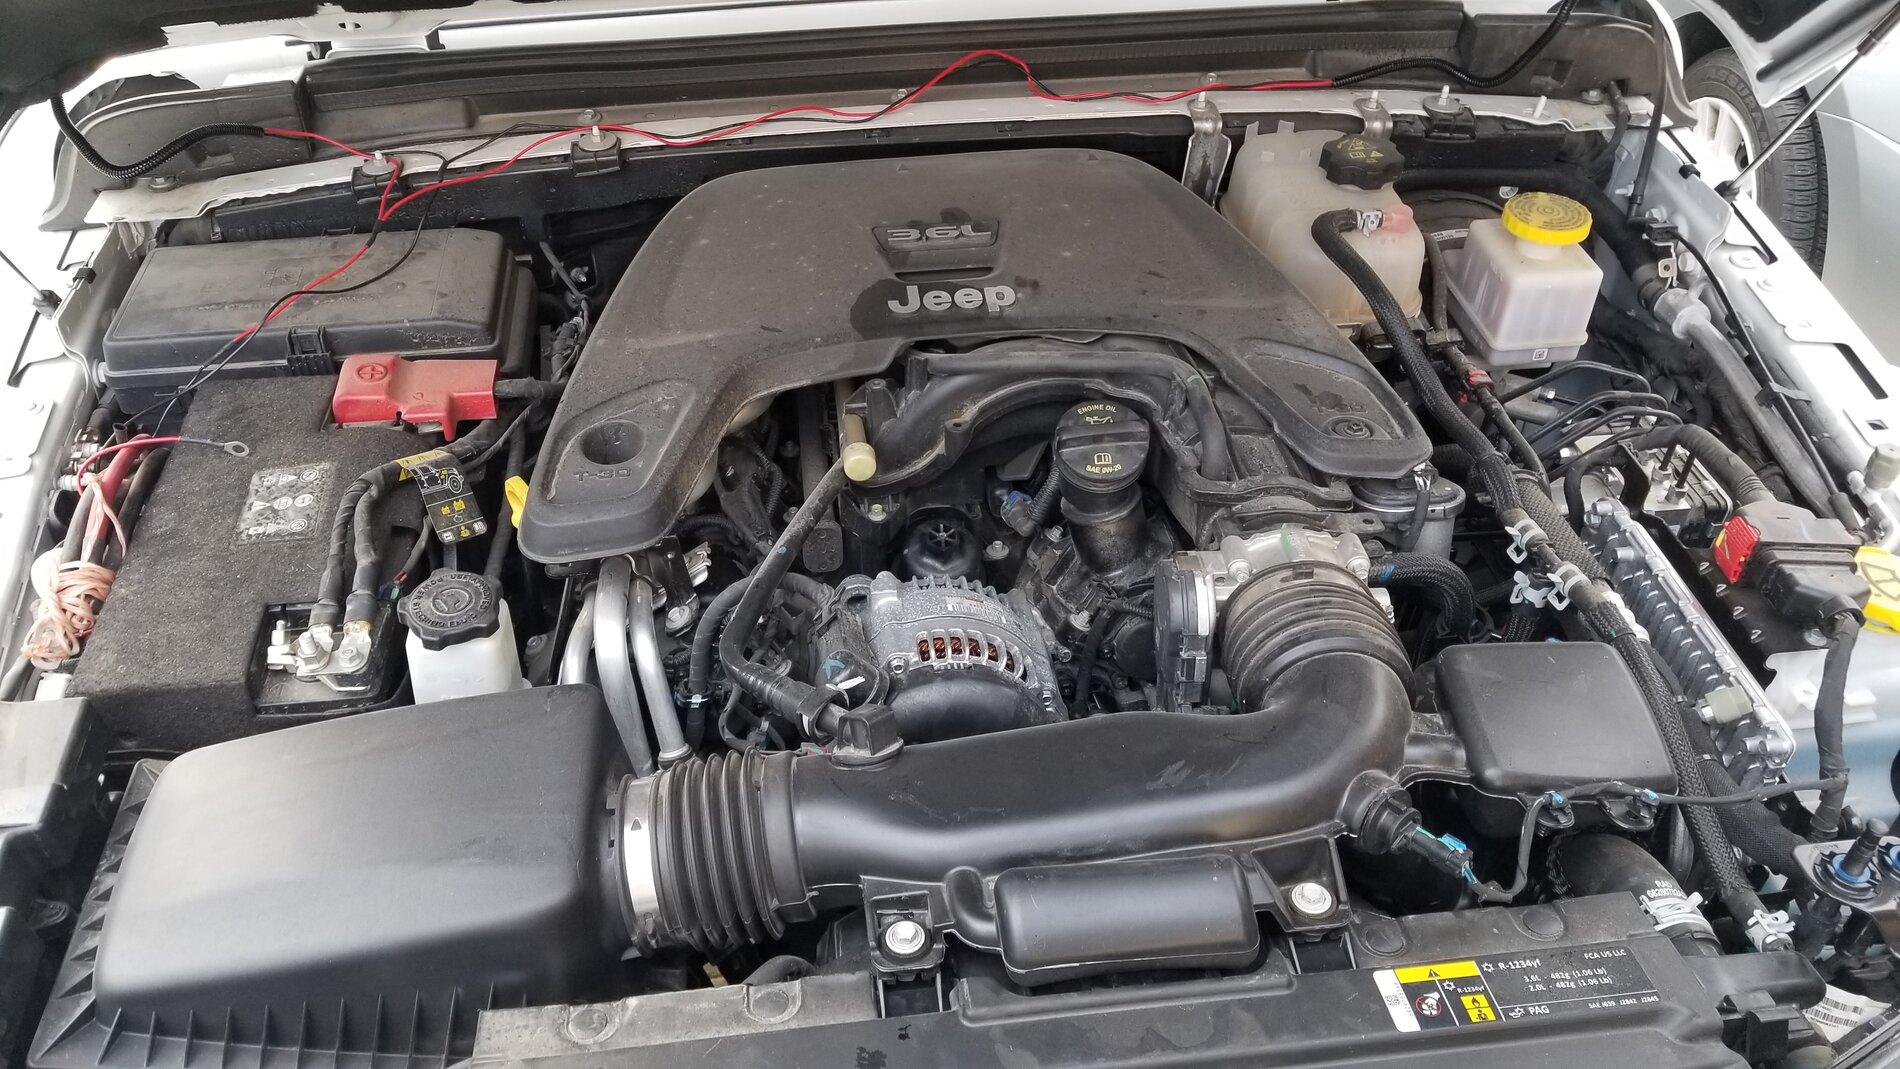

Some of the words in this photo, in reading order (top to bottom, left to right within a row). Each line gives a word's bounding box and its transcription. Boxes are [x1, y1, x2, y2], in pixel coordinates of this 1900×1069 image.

[887, 225, 991, 242] 3.6L
[887, 285, 1016, 313] Jeep
[1077, 404, 1104, 415] ENGINE
[1105, 404, 1117, 413] OIL
[573, 466, 632, 482] T-30
[1085, 464, 1100, 474] SAE
[1101, 463, 1122, 474] 0W-20
[1654, 880, 1673, 888] RAD
[1583, 952, 1600, 960] FCA
[1600, 950, 1612, 958] US
[1612, 949, 1627, 957] LLC
[1498, 958, 1541, 970] R-1234yf
[1523, 974, 1541, 983] 3.6L
[1572, 968, 1593, 979] (1.06
[1593, 966, 1608, 976] Lb)
[1528, 984, 1547, 992] 2.0L
[1577, 978, 1599, 988] (1.06
[1599, 976, 1613, 985] Lb)
[1528, 1005, 1550, 1015] PAG
[1588, 1001, 1601, 1009] SAE
